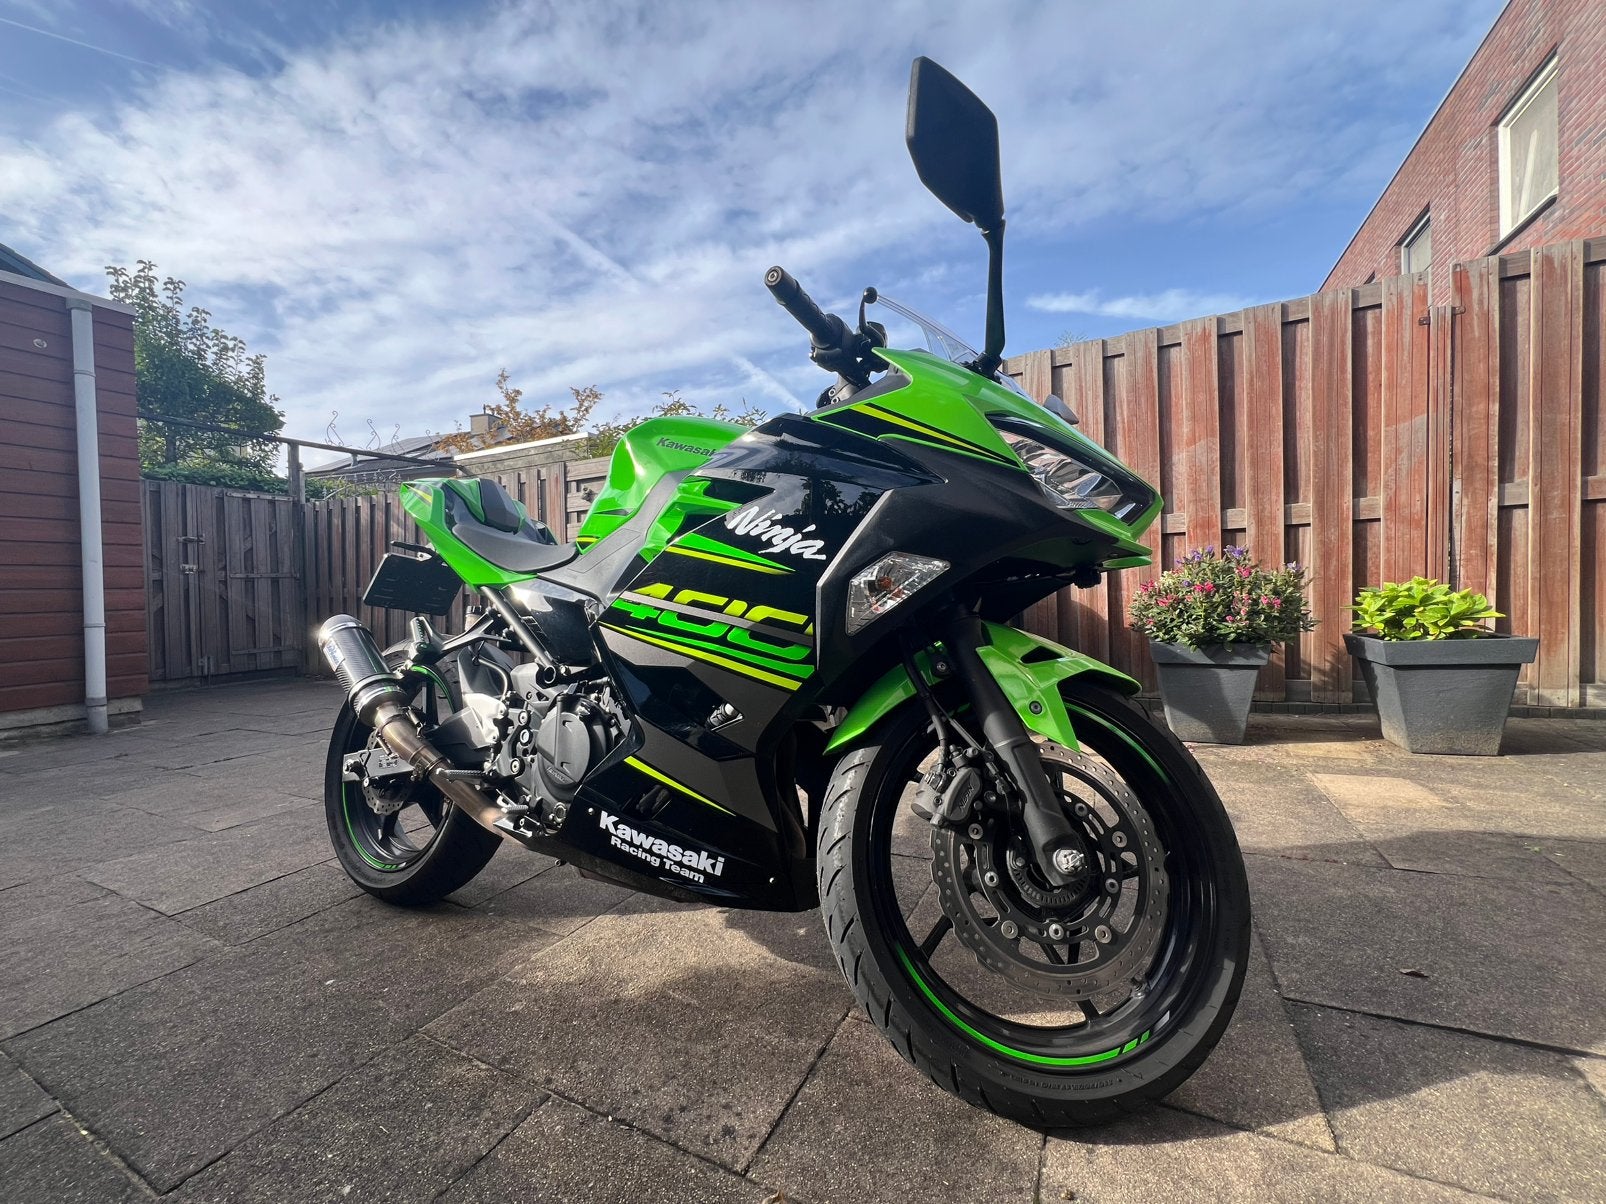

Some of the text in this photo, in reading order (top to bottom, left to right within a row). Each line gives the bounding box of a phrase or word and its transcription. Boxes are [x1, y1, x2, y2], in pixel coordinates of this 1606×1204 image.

[725, 505, 827, 560] Ninja
[600, 810, 725, 876] Kawasaki
[610, 835, 705, 884] Racing Team
